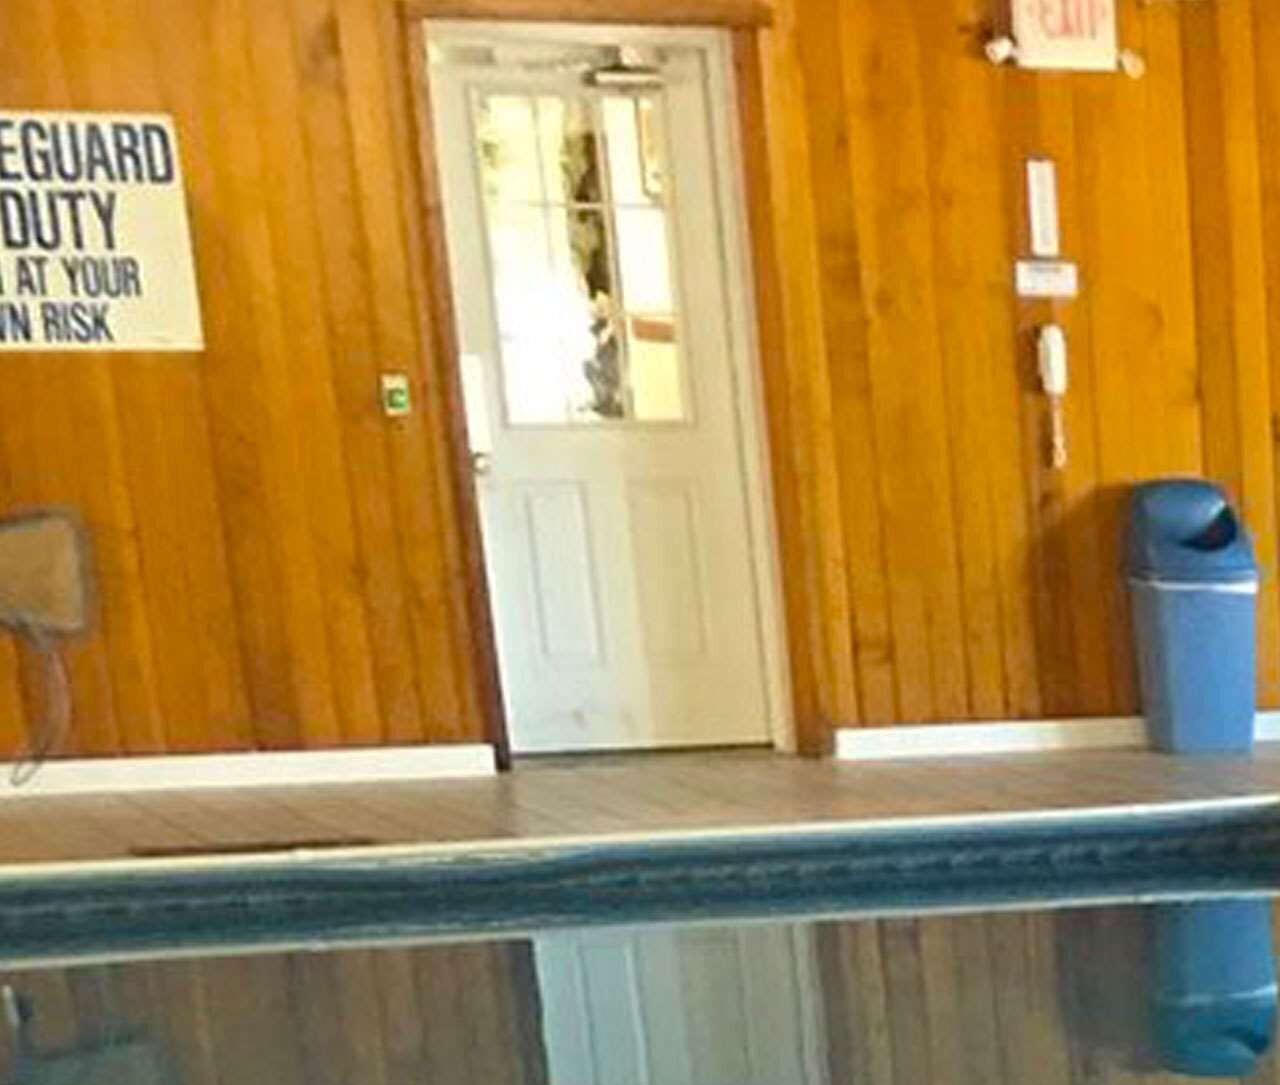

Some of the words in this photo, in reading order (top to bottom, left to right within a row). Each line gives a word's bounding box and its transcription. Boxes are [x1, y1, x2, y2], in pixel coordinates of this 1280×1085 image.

[0, 120, 174, 184] EGUARD
[1, 190, 116, 251] DUTY
[17, 256, 48, 296] AT
[61, 256, 141, 298] YOUR
[41, 302, 115, 342] RISK
